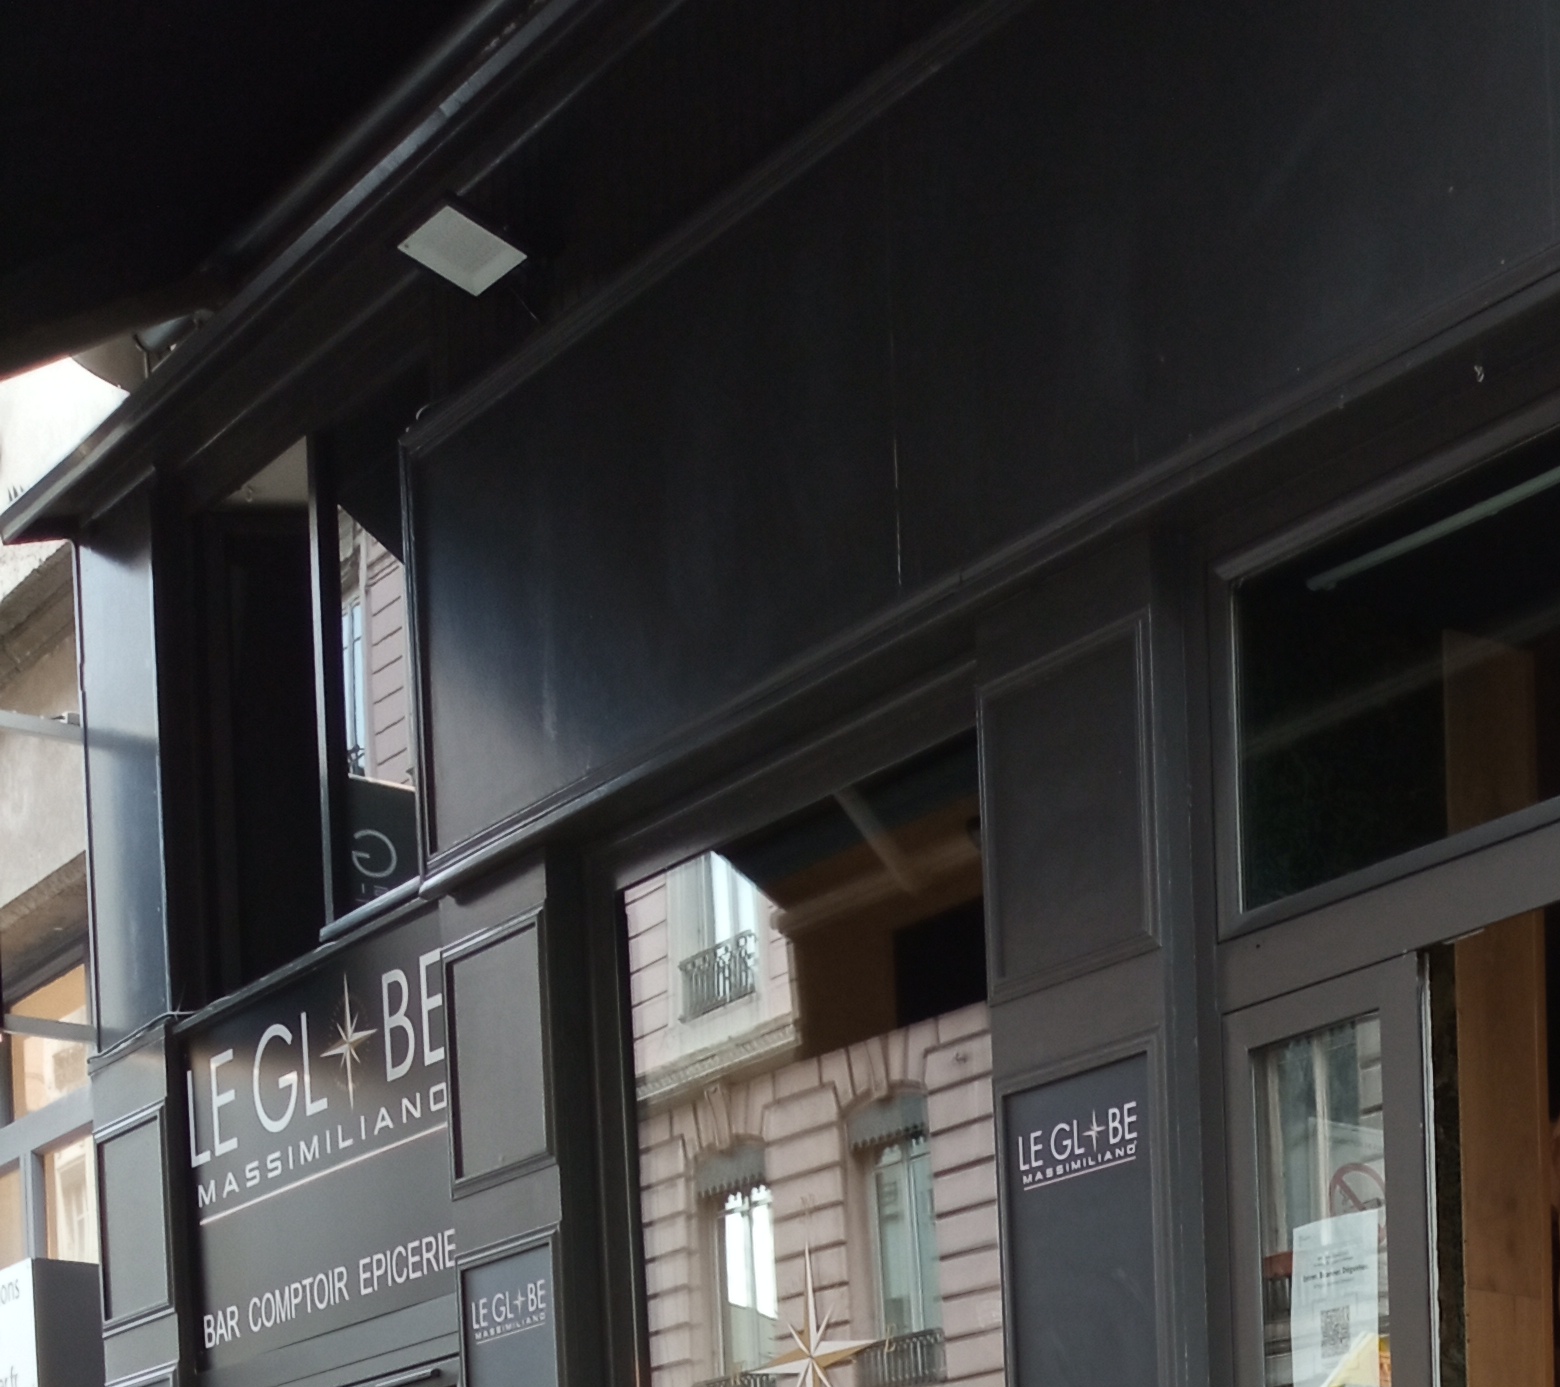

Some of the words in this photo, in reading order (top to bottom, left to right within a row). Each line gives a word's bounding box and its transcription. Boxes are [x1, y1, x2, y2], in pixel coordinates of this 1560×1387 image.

[187, 1049, 238, 1168] LE
[197, 1081, 447, 1209] MASSIMILIANO
[1018, 1130, 1044, 1171] LE
[1022, 1141, 1136, 1185] MASSIMILIANO
[203, 1305, 241, 1349] BAR
[248, 1266, 350, 1333] COMPTOIR
[359, 1227, 456, 1296] EPICERIE
[472, 1297, 489, 1329] LE
